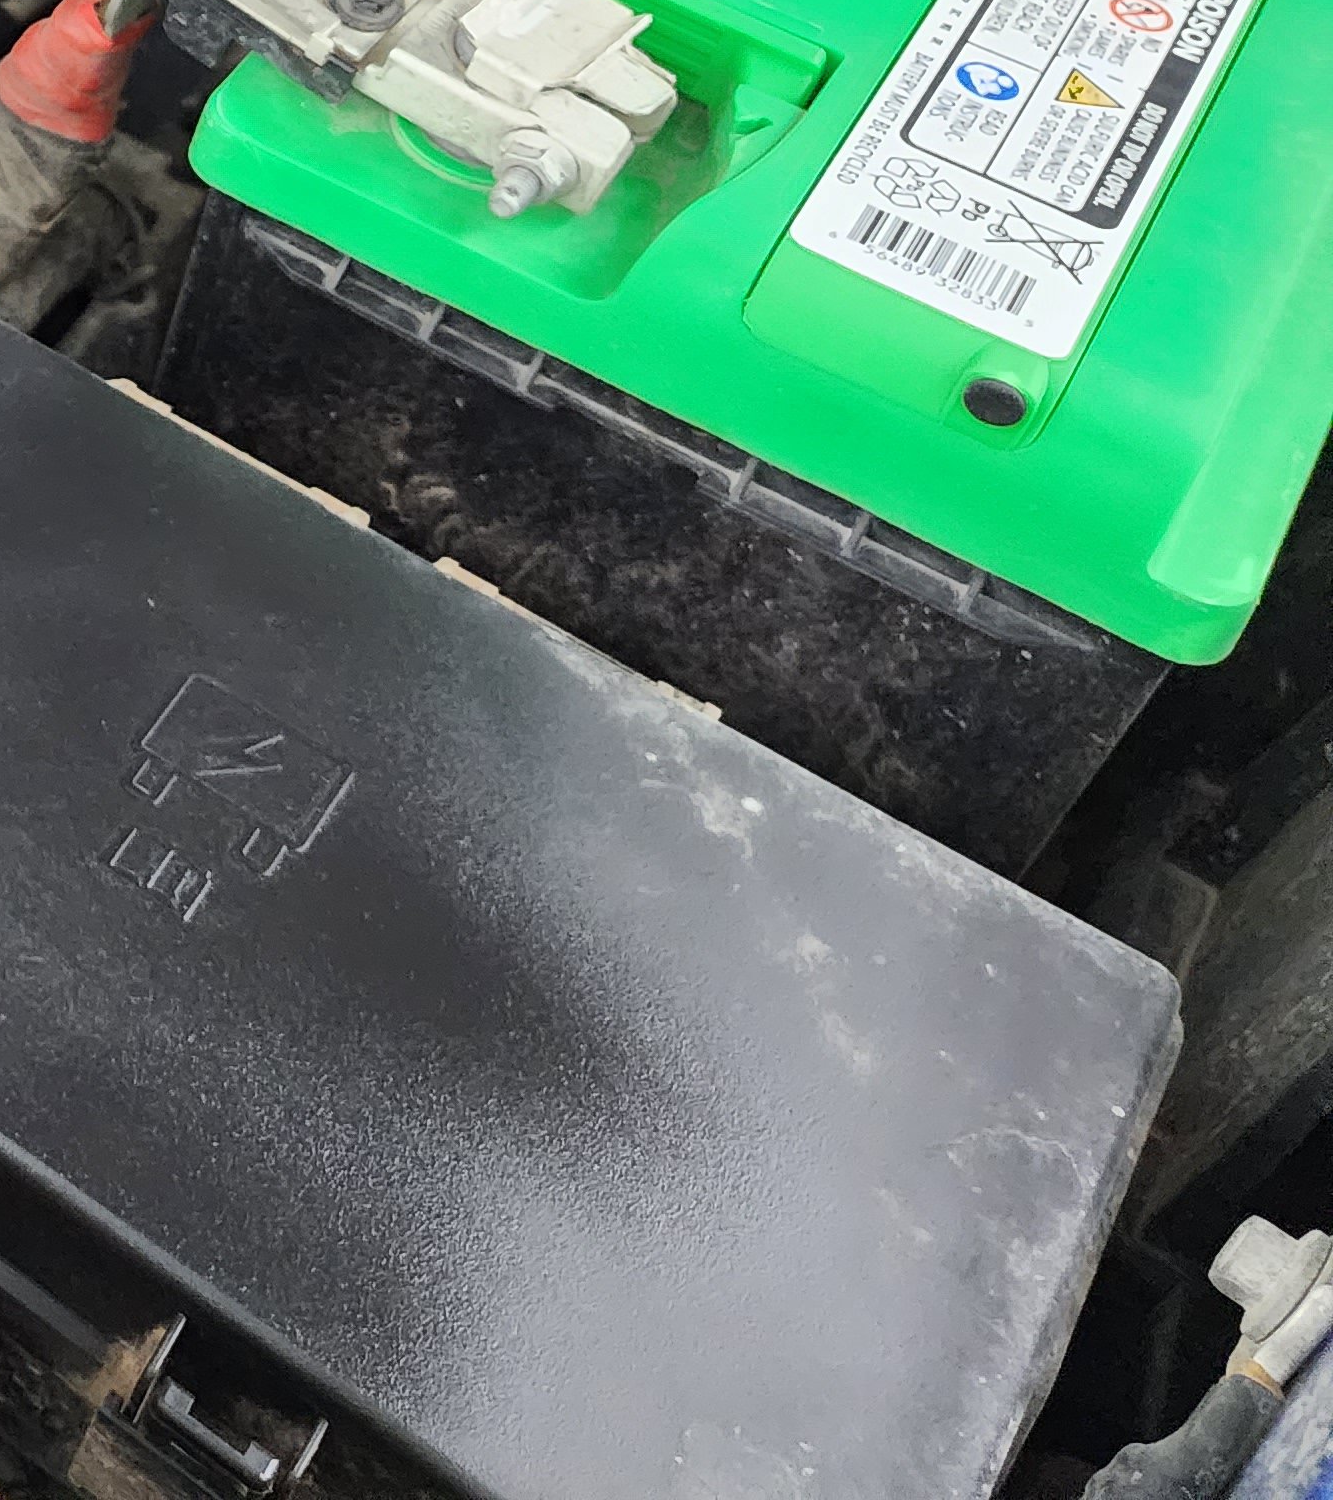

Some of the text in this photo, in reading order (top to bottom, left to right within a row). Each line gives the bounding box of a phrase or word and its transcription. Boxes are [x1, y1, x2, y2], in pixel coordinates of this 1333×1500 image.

[1139, 36, 1162, 54] NO
[835, 51, 934, 186] BATTERY MUST BE RECYCLED
[977, 107, 1008, 137] READ
[1079, 112, 1120, 161] SULFURIC
[1063, 158, 1093, 186] ACID
[959, 198, 991, 226] Pb
[862, 244, 926, 276] 56489
[934, 277, 997, 310] 32833
